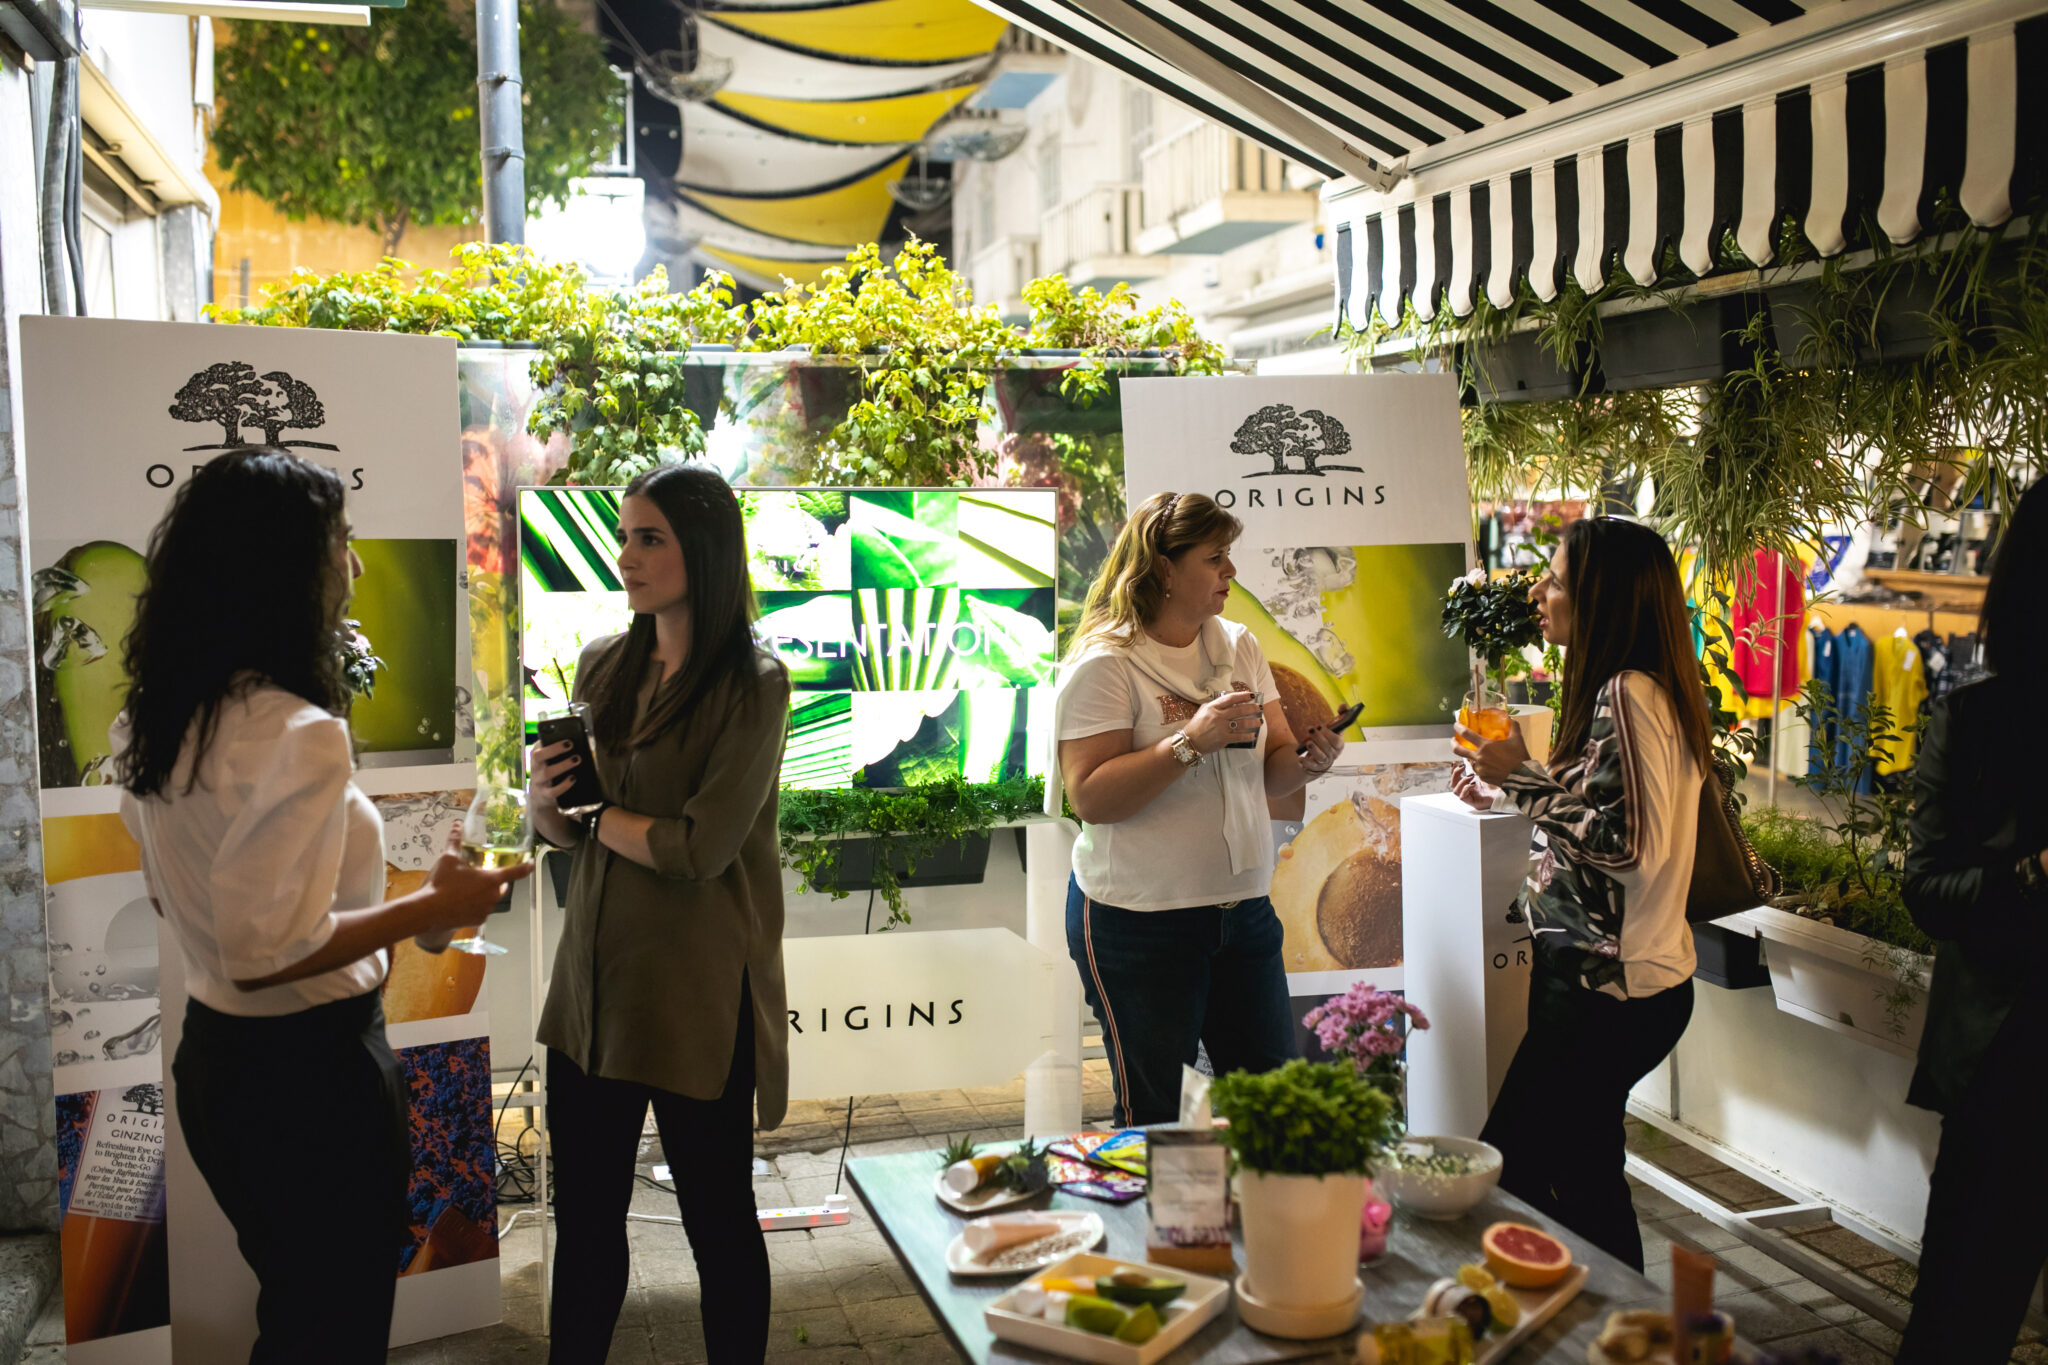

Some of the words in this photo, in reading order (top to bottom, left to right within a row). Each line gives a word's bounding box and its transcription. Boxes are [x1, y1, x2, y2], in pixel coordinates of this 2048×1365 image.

[1215, 485, 1385, 508] ORIGINS
[111, 1129, 163, 1144] GINZING
[96, 1140, 135, 1153] Refreshing
[136, 1145, 151, 1155] Eye
[104, 1150, 137, 1162] Brighten
[138, 1153, 146, 1162] &
[111, 1159, 151, 1171] On-the-Go
